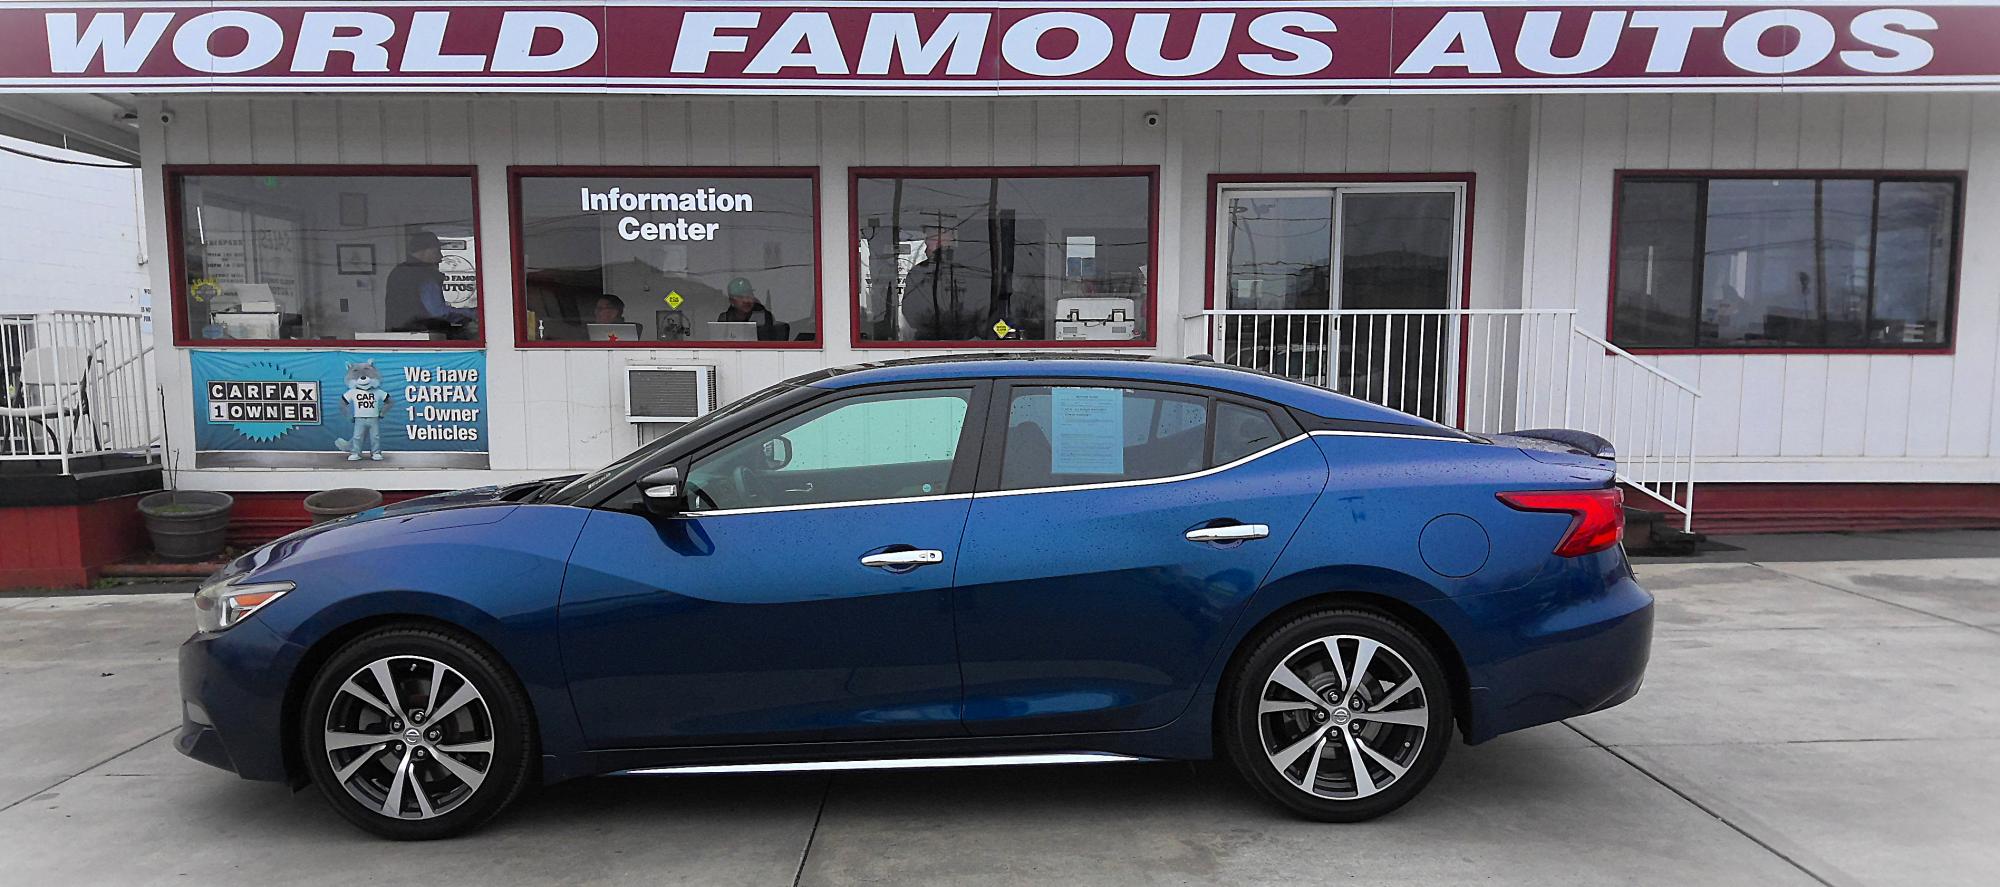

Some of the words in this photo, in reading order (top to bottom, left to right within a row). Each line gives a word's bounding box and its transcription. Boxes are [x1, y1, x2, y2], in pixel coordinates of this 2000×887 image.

[45, 10, 599, 74] WORLD
[670, 11, 1338, 77] FAMOUS
[1394, 8, 1939, 75] AUTOS
[581, 187, 753, 212] Information
[618, 216, 719, 241] Center
[443, 283, 474, 291] UTOS
[404, 366, 431, 382] We
[437, 366, 478, 382] have
[211, 384, 314, 401] CARFAX
[405, 385, 478, 403] CARFAX
[406, 405, 479, 421] 1-Owner
[406, 424, 478, 440] Vehicles
